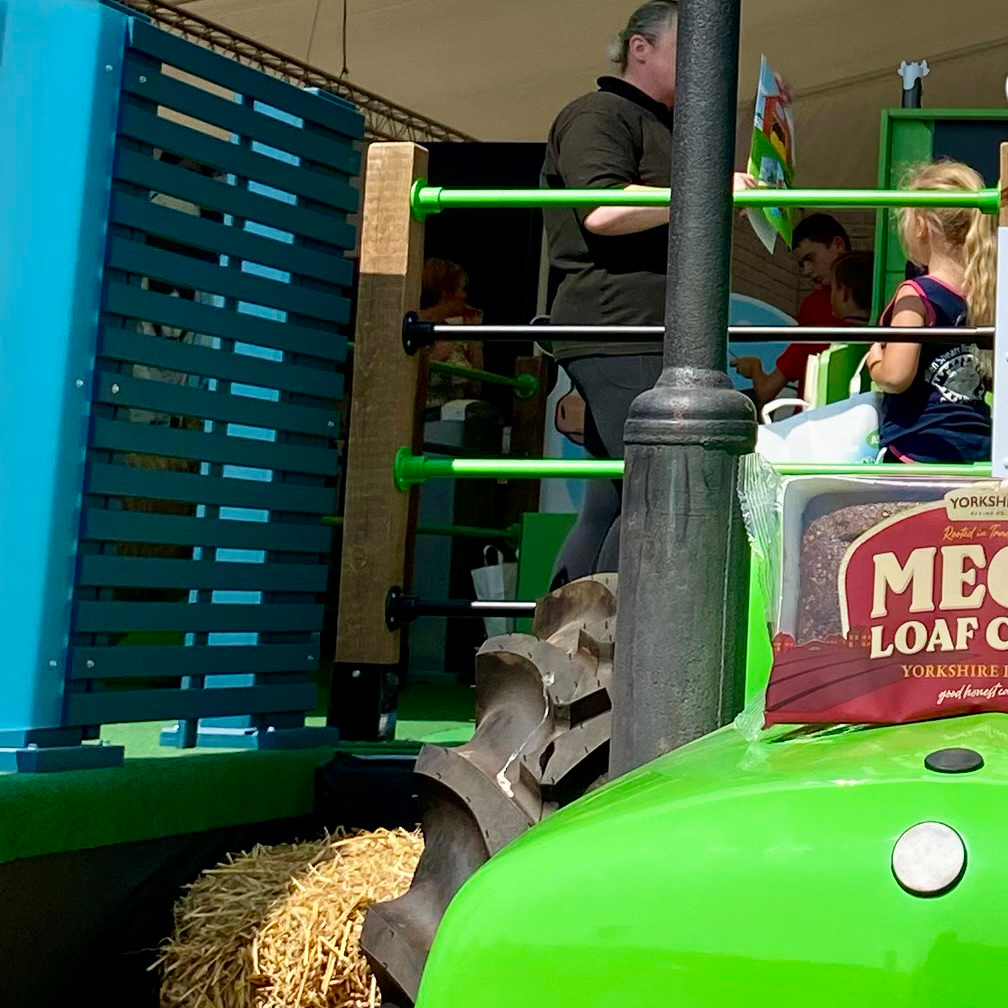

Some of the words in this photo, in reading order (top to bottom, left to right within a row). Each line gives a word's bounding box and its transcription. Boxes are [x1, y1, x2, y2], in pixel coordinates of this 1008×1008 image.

[870, 616, 979, 660] LOAF
[902, 664, 998, 679] YORKSHIRE
[937, 684, 964, 704] good
[962, 683, 1001, 698] honest
